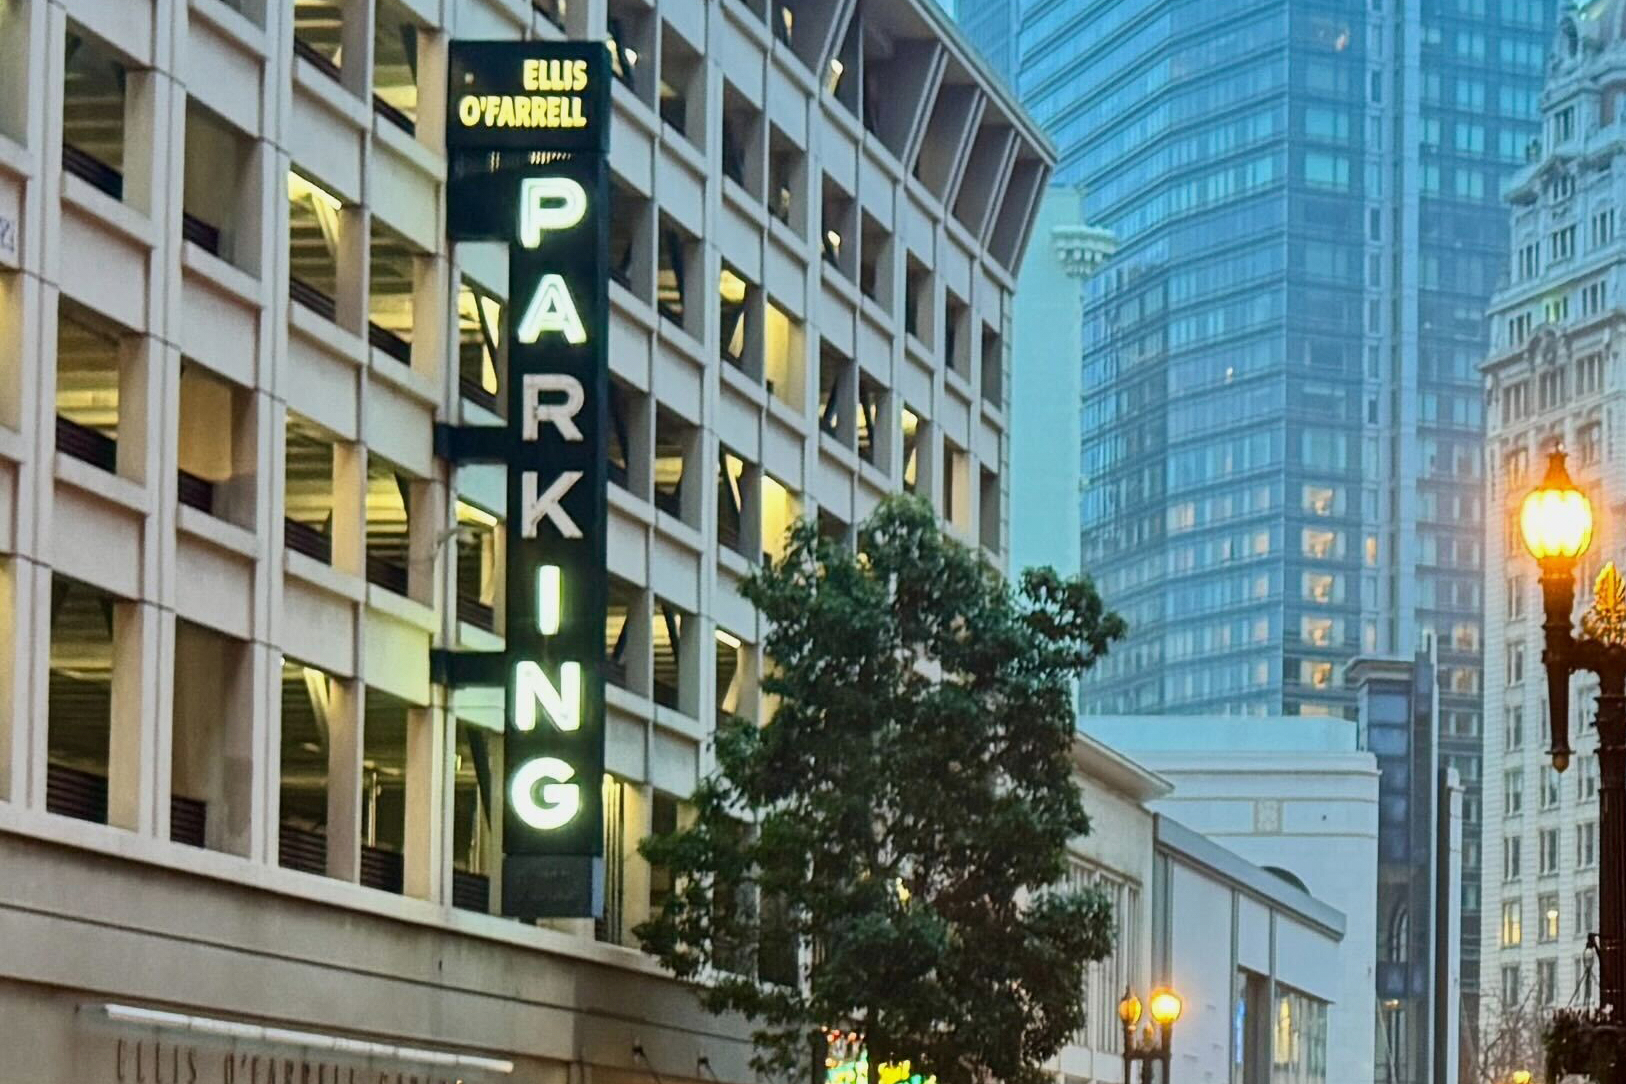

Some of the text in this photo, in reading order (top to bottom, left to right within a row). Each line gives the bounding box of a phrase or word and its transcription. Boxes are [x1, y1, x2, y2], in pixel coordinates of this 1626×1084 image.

[523, 59, 587, 91] ELLIS
[459, 95, 587, 128] O'FARRELL
[510, 177, 587, 831] PARKING
